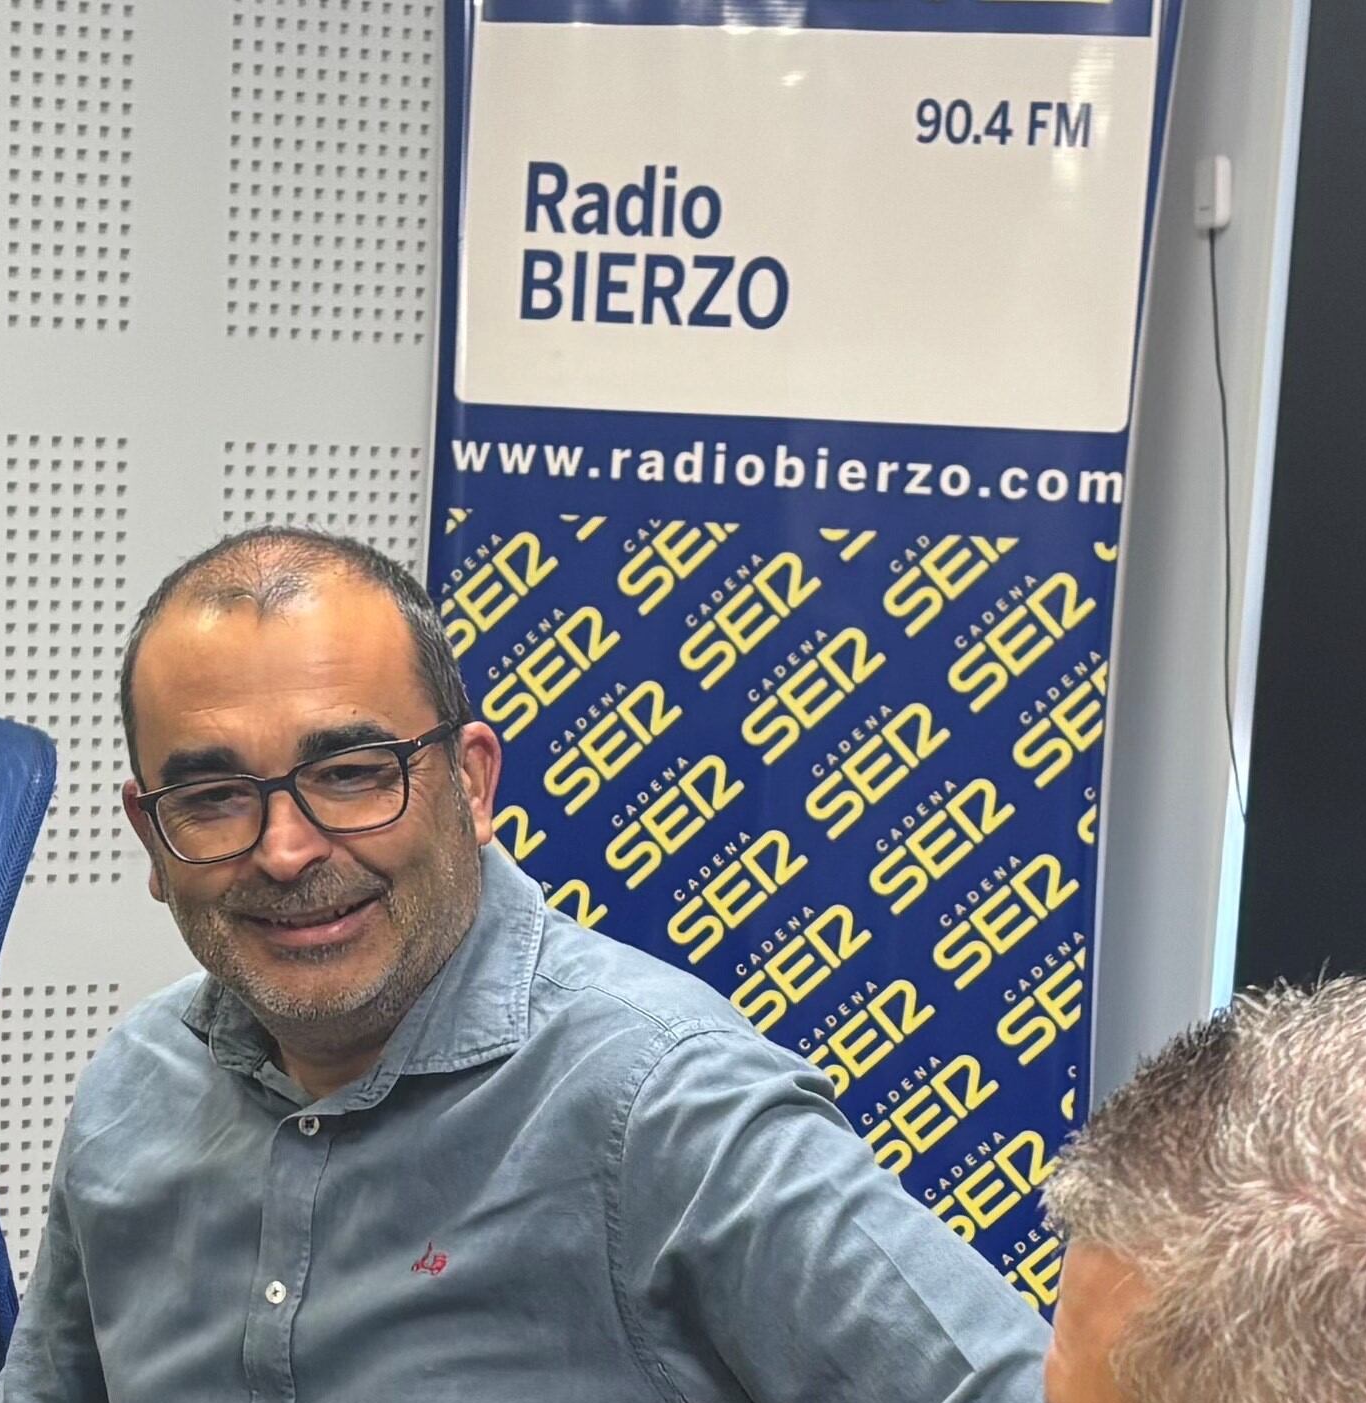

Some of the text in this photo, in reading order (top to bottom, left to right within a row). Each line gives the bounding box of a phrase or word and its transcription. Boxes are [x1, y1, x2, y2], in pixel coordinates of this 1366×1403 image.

[915, 98, 1092, 149] 90.4 FM
[523, 161, 723, 240] Radio
[518, 248, 790, 331] BIERZO
[451, 438, 1124, 505] www.radiobierzo.com
[679, 552, 822, 690] SER
[686, 554, 764, 628] CADENA
[954, 575, 1037, 649] CADENA
[481, 606, 621, 742] SER
[489, 608, 565, 680] CADENA
[747, 629, 828, 702] CADENA
[947, 572, 1097, 713] SER
[550, 683, 627, 754] CADENA
[742, 627, 886, 766] SER
[1019, 651, 1102, 725] CADENA
[543, 681, 683, 816] SER
[811, 704, 893, 777] CADENA
[1013, 665, 1110, 789] SE
[612, 757, 689, 828] CADENA
[805, 702, 951, 840] SER
[605, 755, 744, 890] SER
[869, 778, 1016, 916] SER
[875, 780, 957, 853] CADENA
[667, 830, 809, 965] SER
[673, 832, 751, 902] CADENA
[939, 855, 1022, 927] CADENA
[735, 906, 815, 976] CADENA
[933, 854, 1080, 991] SER
[730, 905, 873, 1035] SER
[1003, 931, 1085, 1003] CADENA
[798, 981, 878, 1051] CADENA
[996, 950, 1087, 1066] SE
[861, 1056, 942, 1126] CADENA
[924, 1131, 1005, 1201] CADENA
